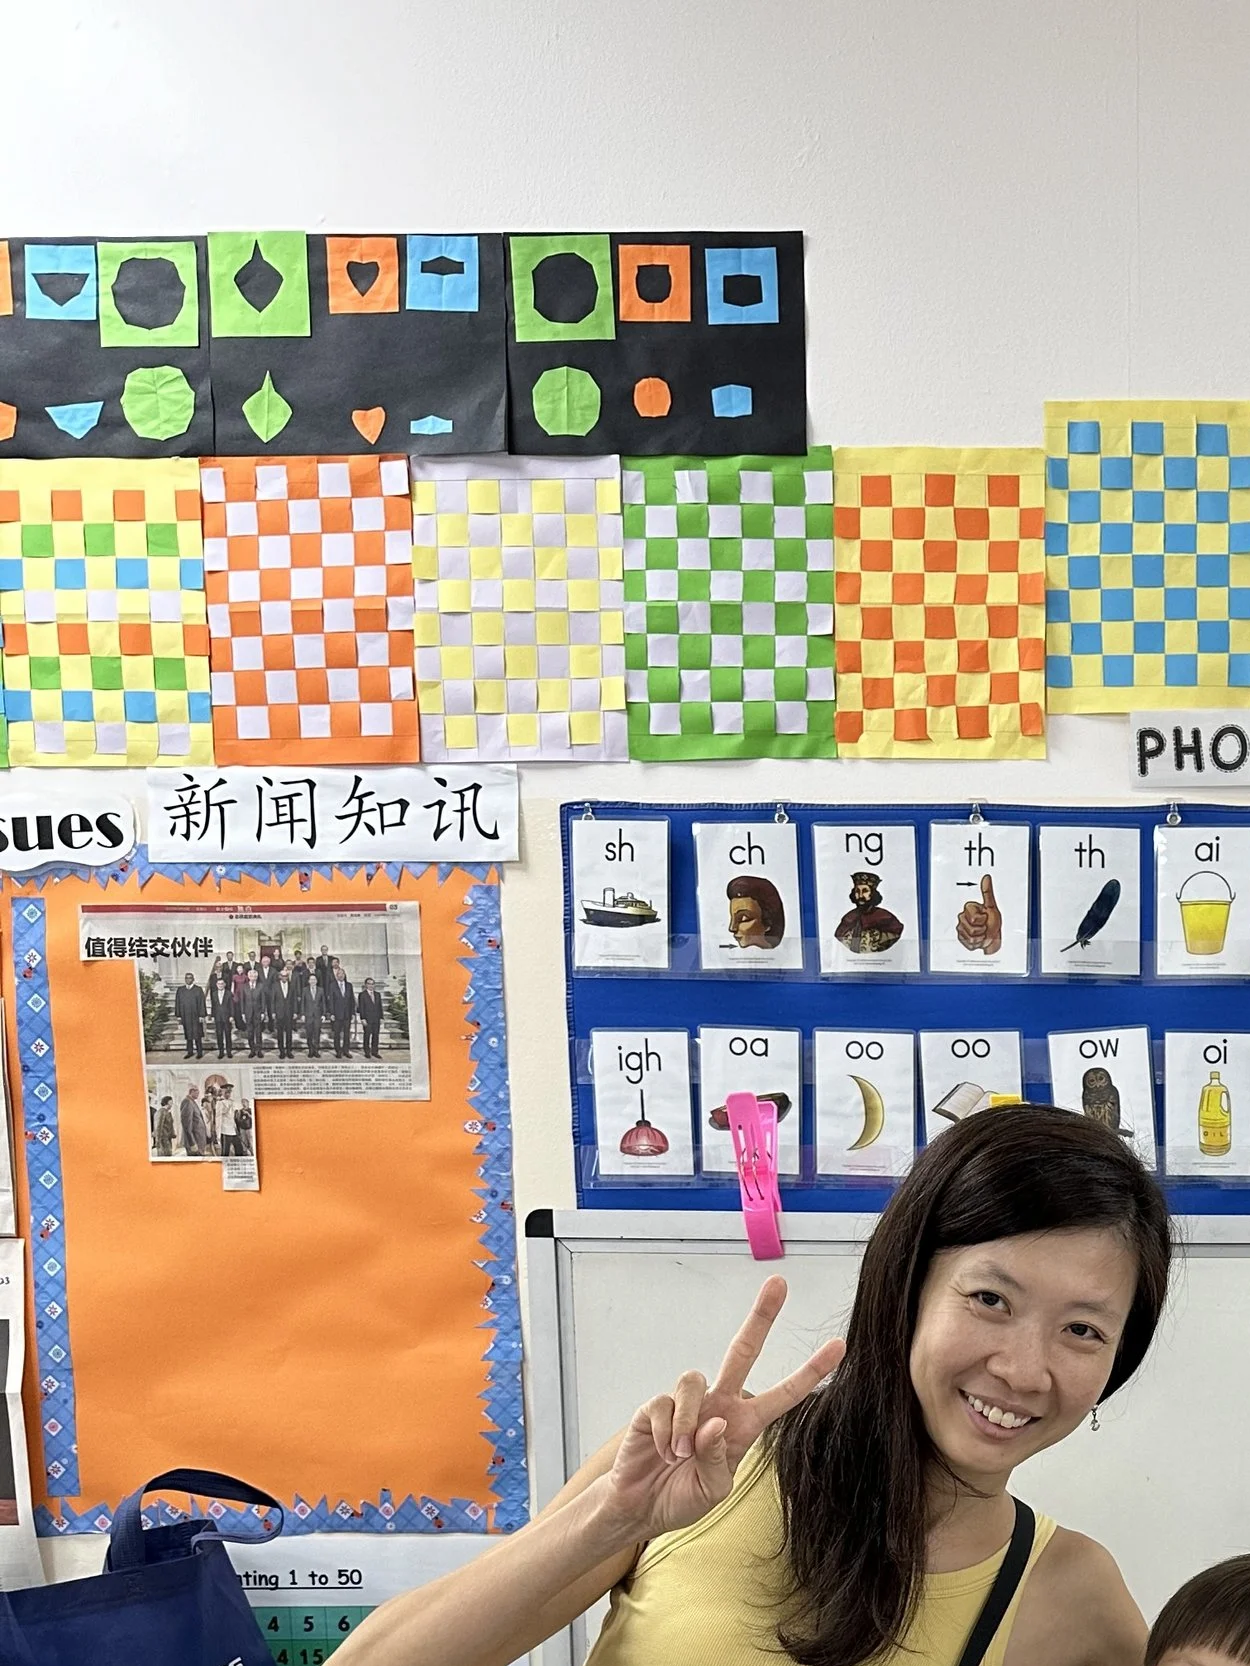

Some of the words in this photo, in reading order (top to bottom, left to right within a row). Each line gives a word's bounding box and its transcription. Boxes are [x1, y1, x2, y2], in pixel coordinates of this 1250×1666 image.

[164, 774, 499, 849] 新闻知讯
[605, 828, 634, 862] sh
[729, 832, 765, 865] ch
[846, 833, 883, 866] ng
[964, 834, 994, 866] th
[1075, 834, 1104, 868] th
[1195, 836, 1220, 861] ai
[85, 937, 213, 958] 值得结交伙伴
[729, 1037, 768, 1057] oa
[846, 1041, 884, 1060] oo
[951, 1039, 990, 1058] oo
[1079, 1038, 1119, 1059] ow
[1203, 1039, 1227, 1064] oi
[618, 1039, 661, 1084] igh
[290, 1570, 298, 1585] 1
[308, 1571, 328, 1585] to
[338, 1569, 362, 1584] 50
[268, 1617, 280, 1631] 4
[304, 1616, 314, 1631] 5
[338, 1616, 350, 1631] 6
[277, 1650, 288, 1664] 4
[300, 1650, 323, 1664] 15
